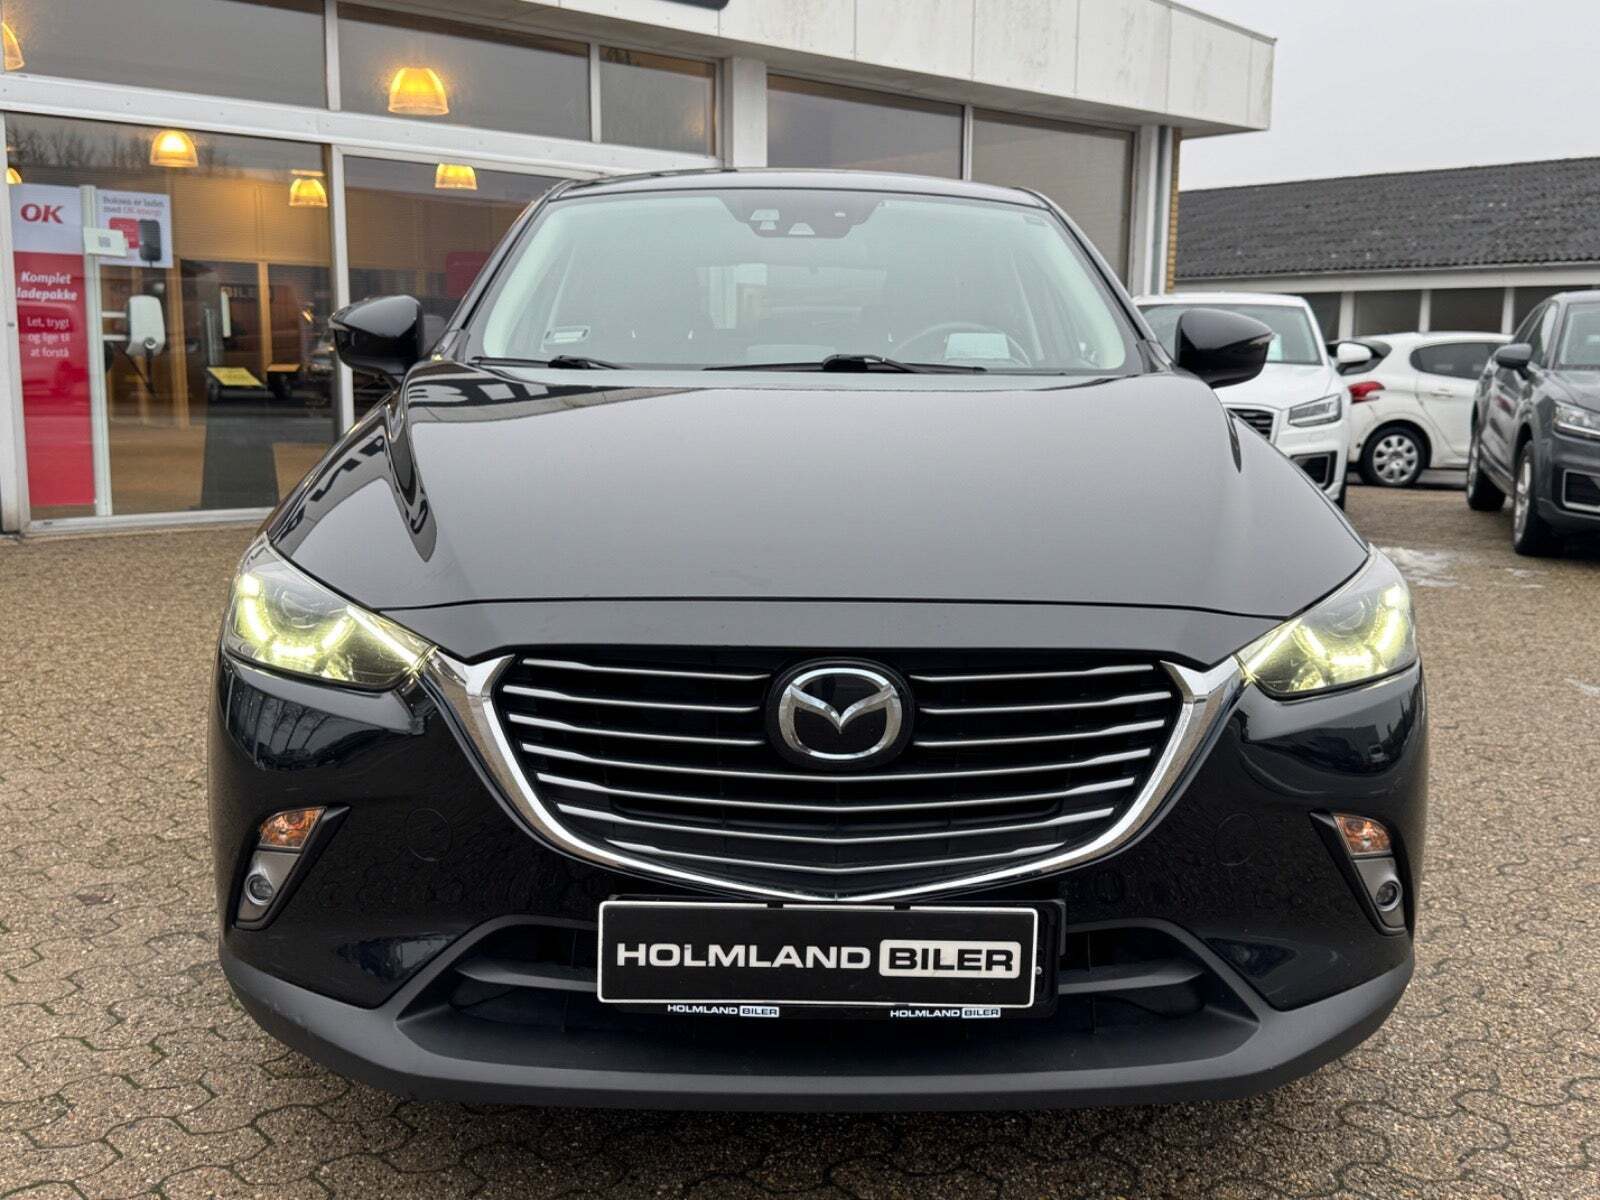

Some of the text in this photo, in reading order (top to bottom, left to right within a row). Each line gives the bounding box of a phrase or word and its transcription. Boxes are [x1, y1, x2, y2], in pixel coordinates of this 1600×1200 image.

[20, 203, 64, 224] OK
[21, 271, 72, 286] Komplet
[17, 287, 77, 302] ladepakke
[47, 318, 69, 330] trygt
[28, 334, 40, 344] og
[30, 347, 69, 357] at forstå
[616, 942, 1016, 972] HOLMLAND BILER
[667, 1004, 777, 1016] HOLMLAND BILER
[890, 1008, 999, 1018] HOLMLAND BILER
